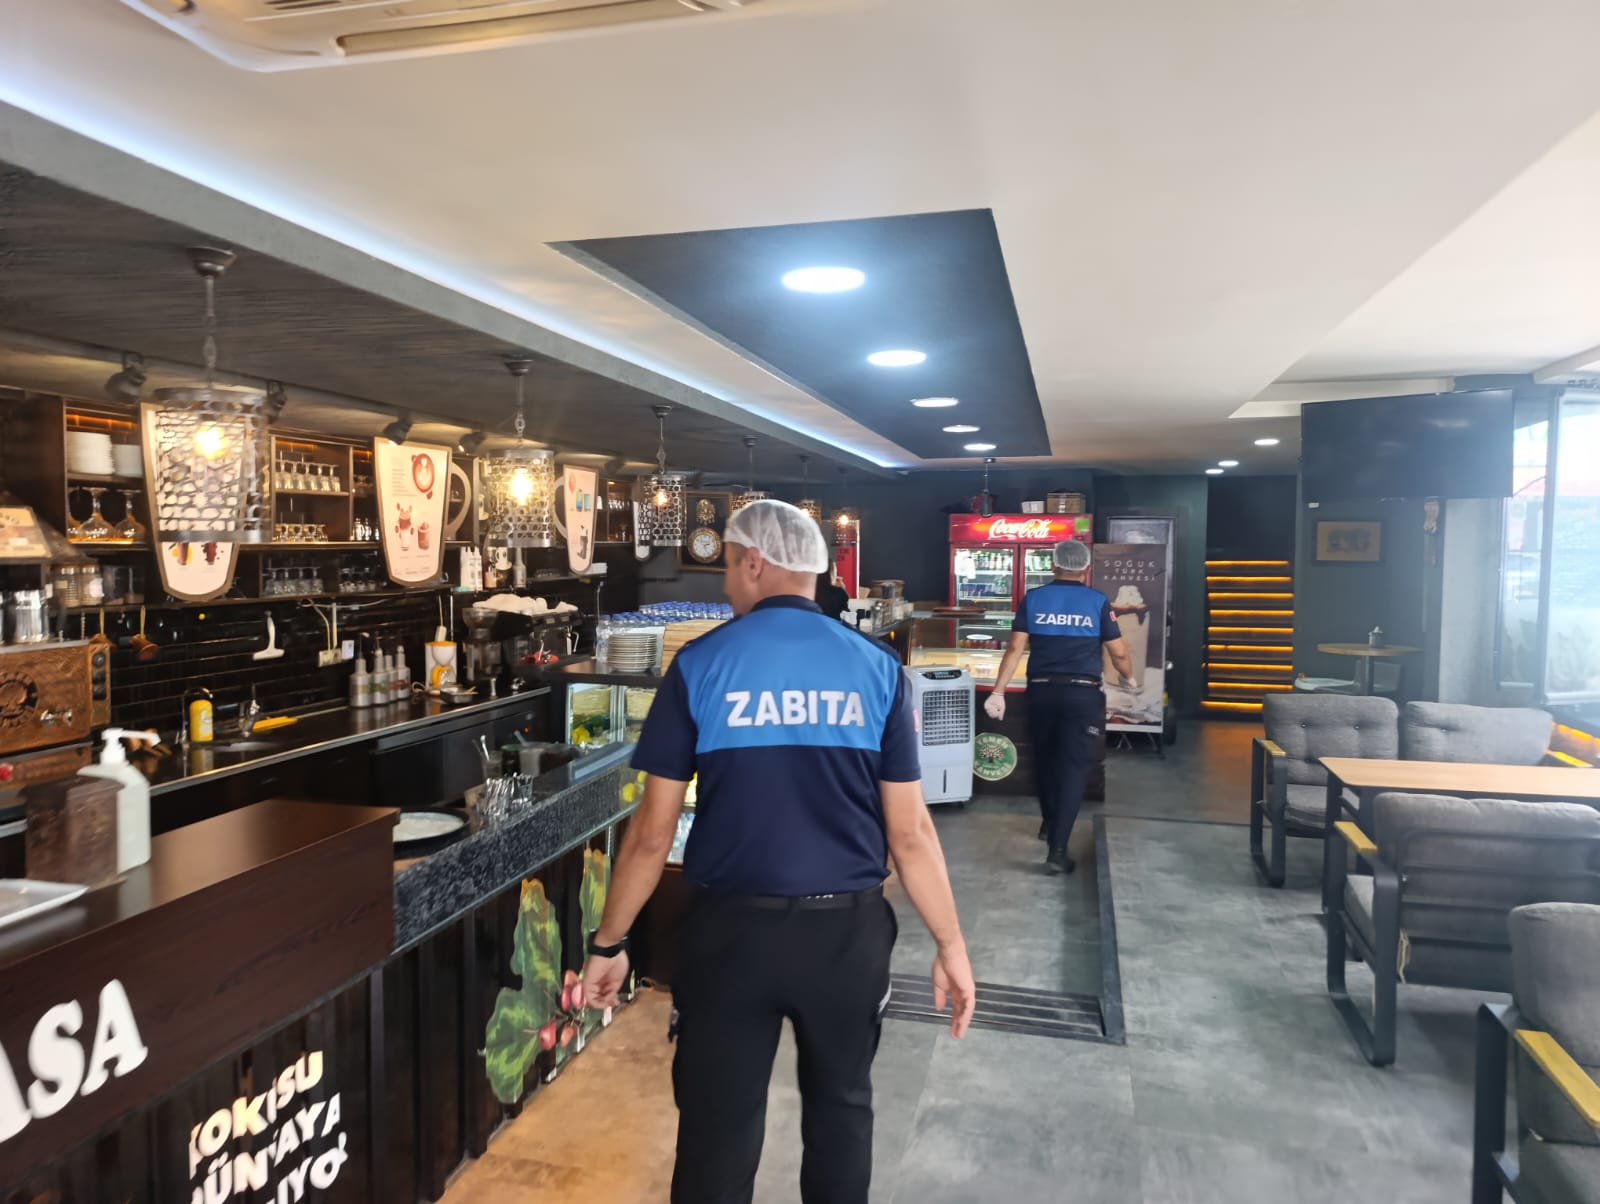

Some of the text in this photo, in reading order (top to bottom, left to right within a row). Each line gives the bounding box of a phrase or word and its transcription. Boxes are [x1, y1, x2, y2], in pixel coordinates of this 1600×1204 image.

[988, 518, 1055, 540] Coca-Cola
[1034, 613, 1094, 628] ZABITA
[725, 690, 865, 727] ZABITA
